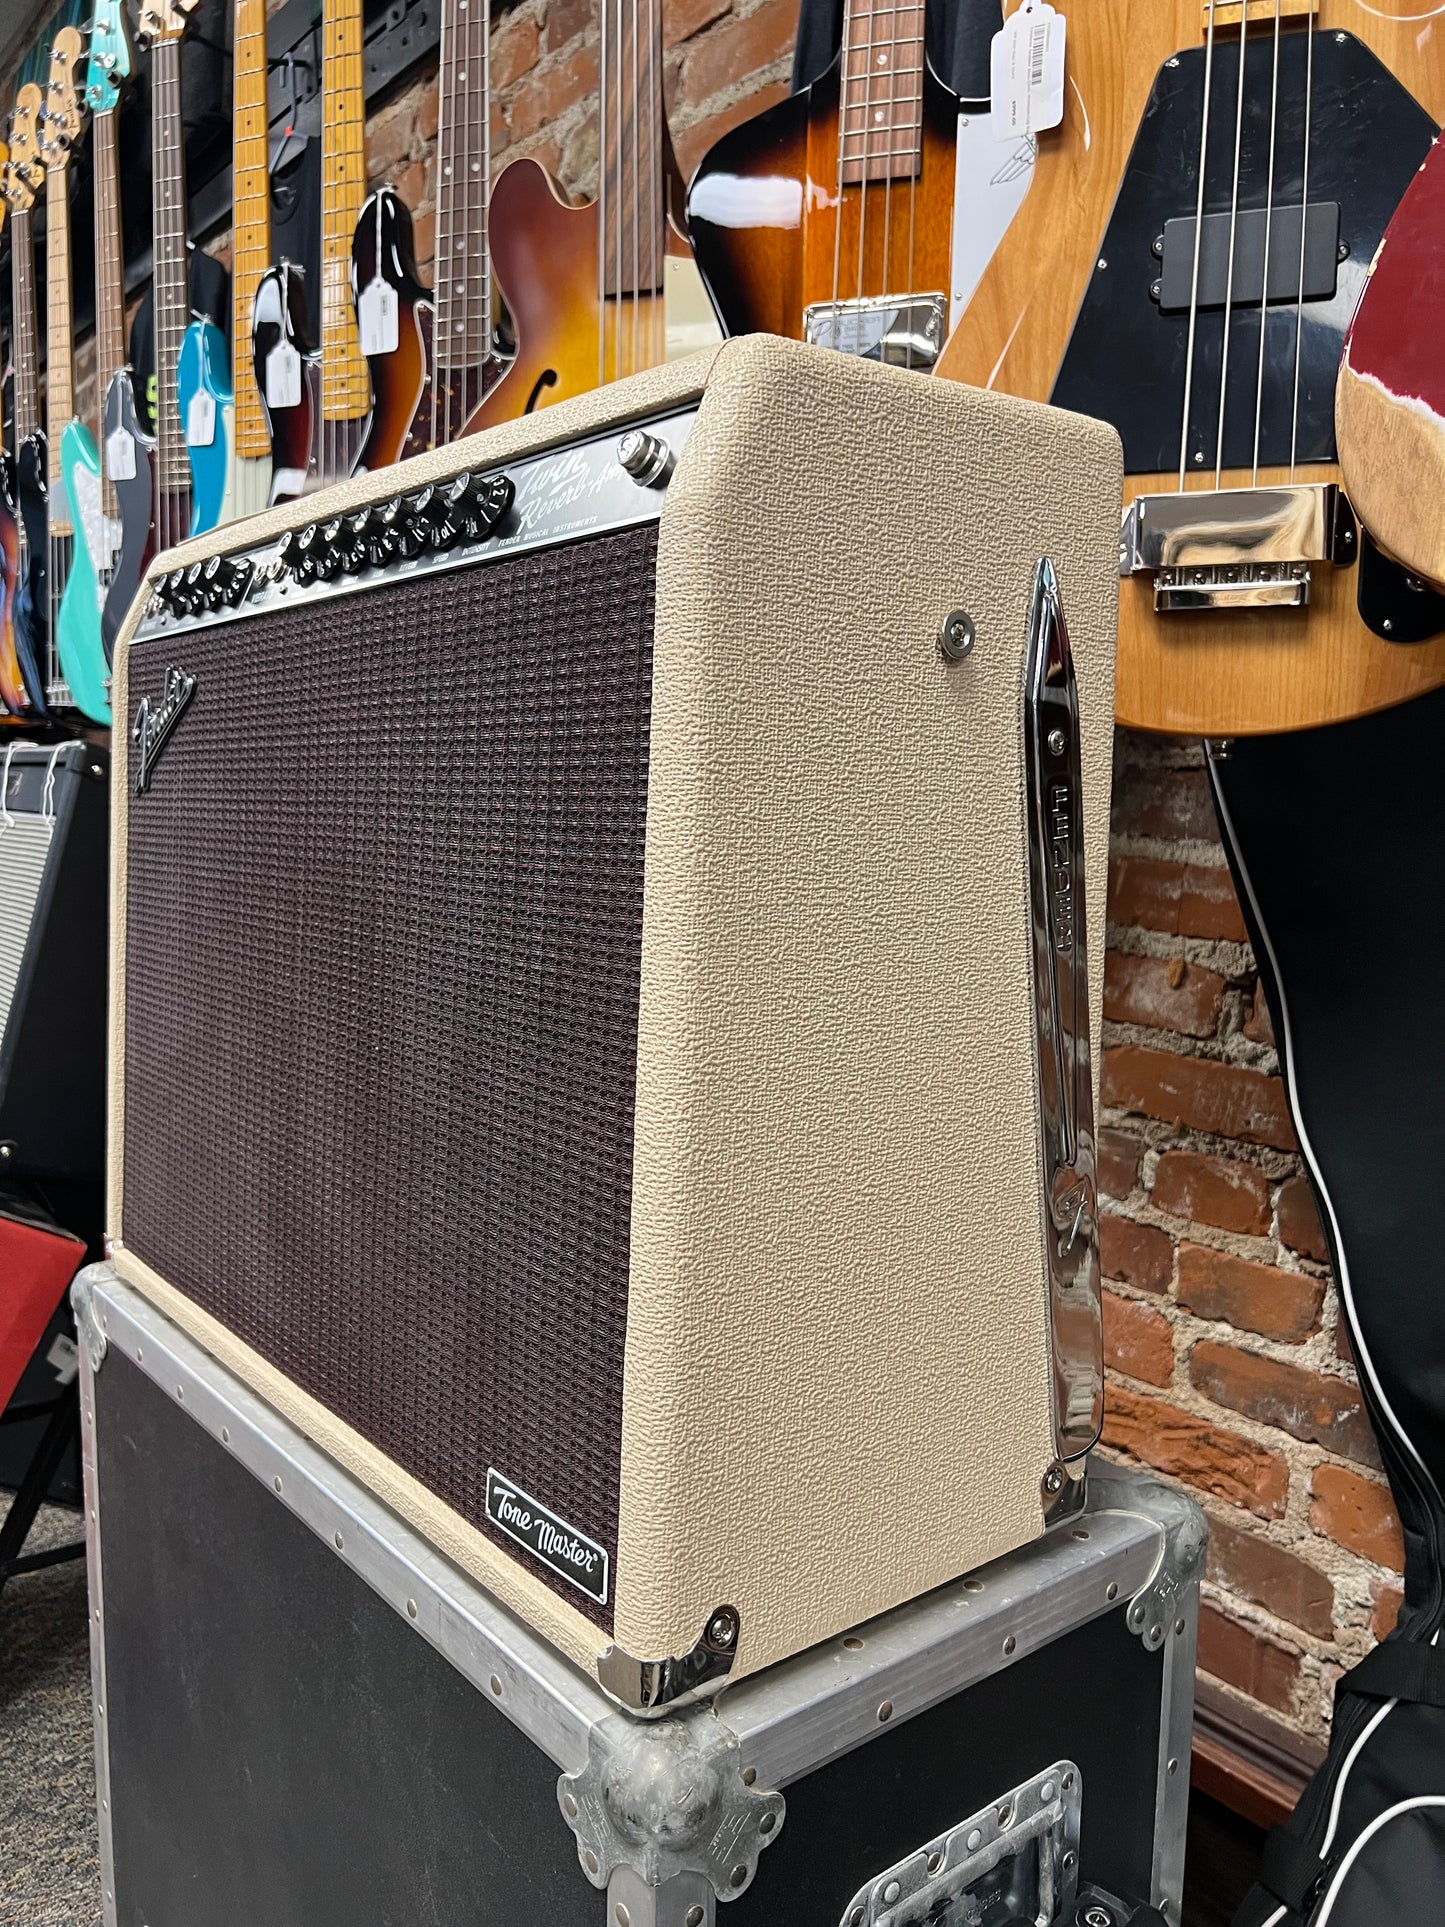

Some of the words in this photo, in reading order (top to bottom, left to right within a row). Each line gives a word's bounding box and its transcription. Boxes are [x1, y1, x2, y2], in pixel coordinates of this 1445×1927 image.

[518, 449, 589, 502] Twin
[498, 534, 521, 548] FENDER
[523, 527, 550, 542] MUSICAL
[552, 515, 598, 535] INSTRUMENTS
[1051, 785, 1073, 950] FENDER
[493, 1486, 532, 1531] Tone
